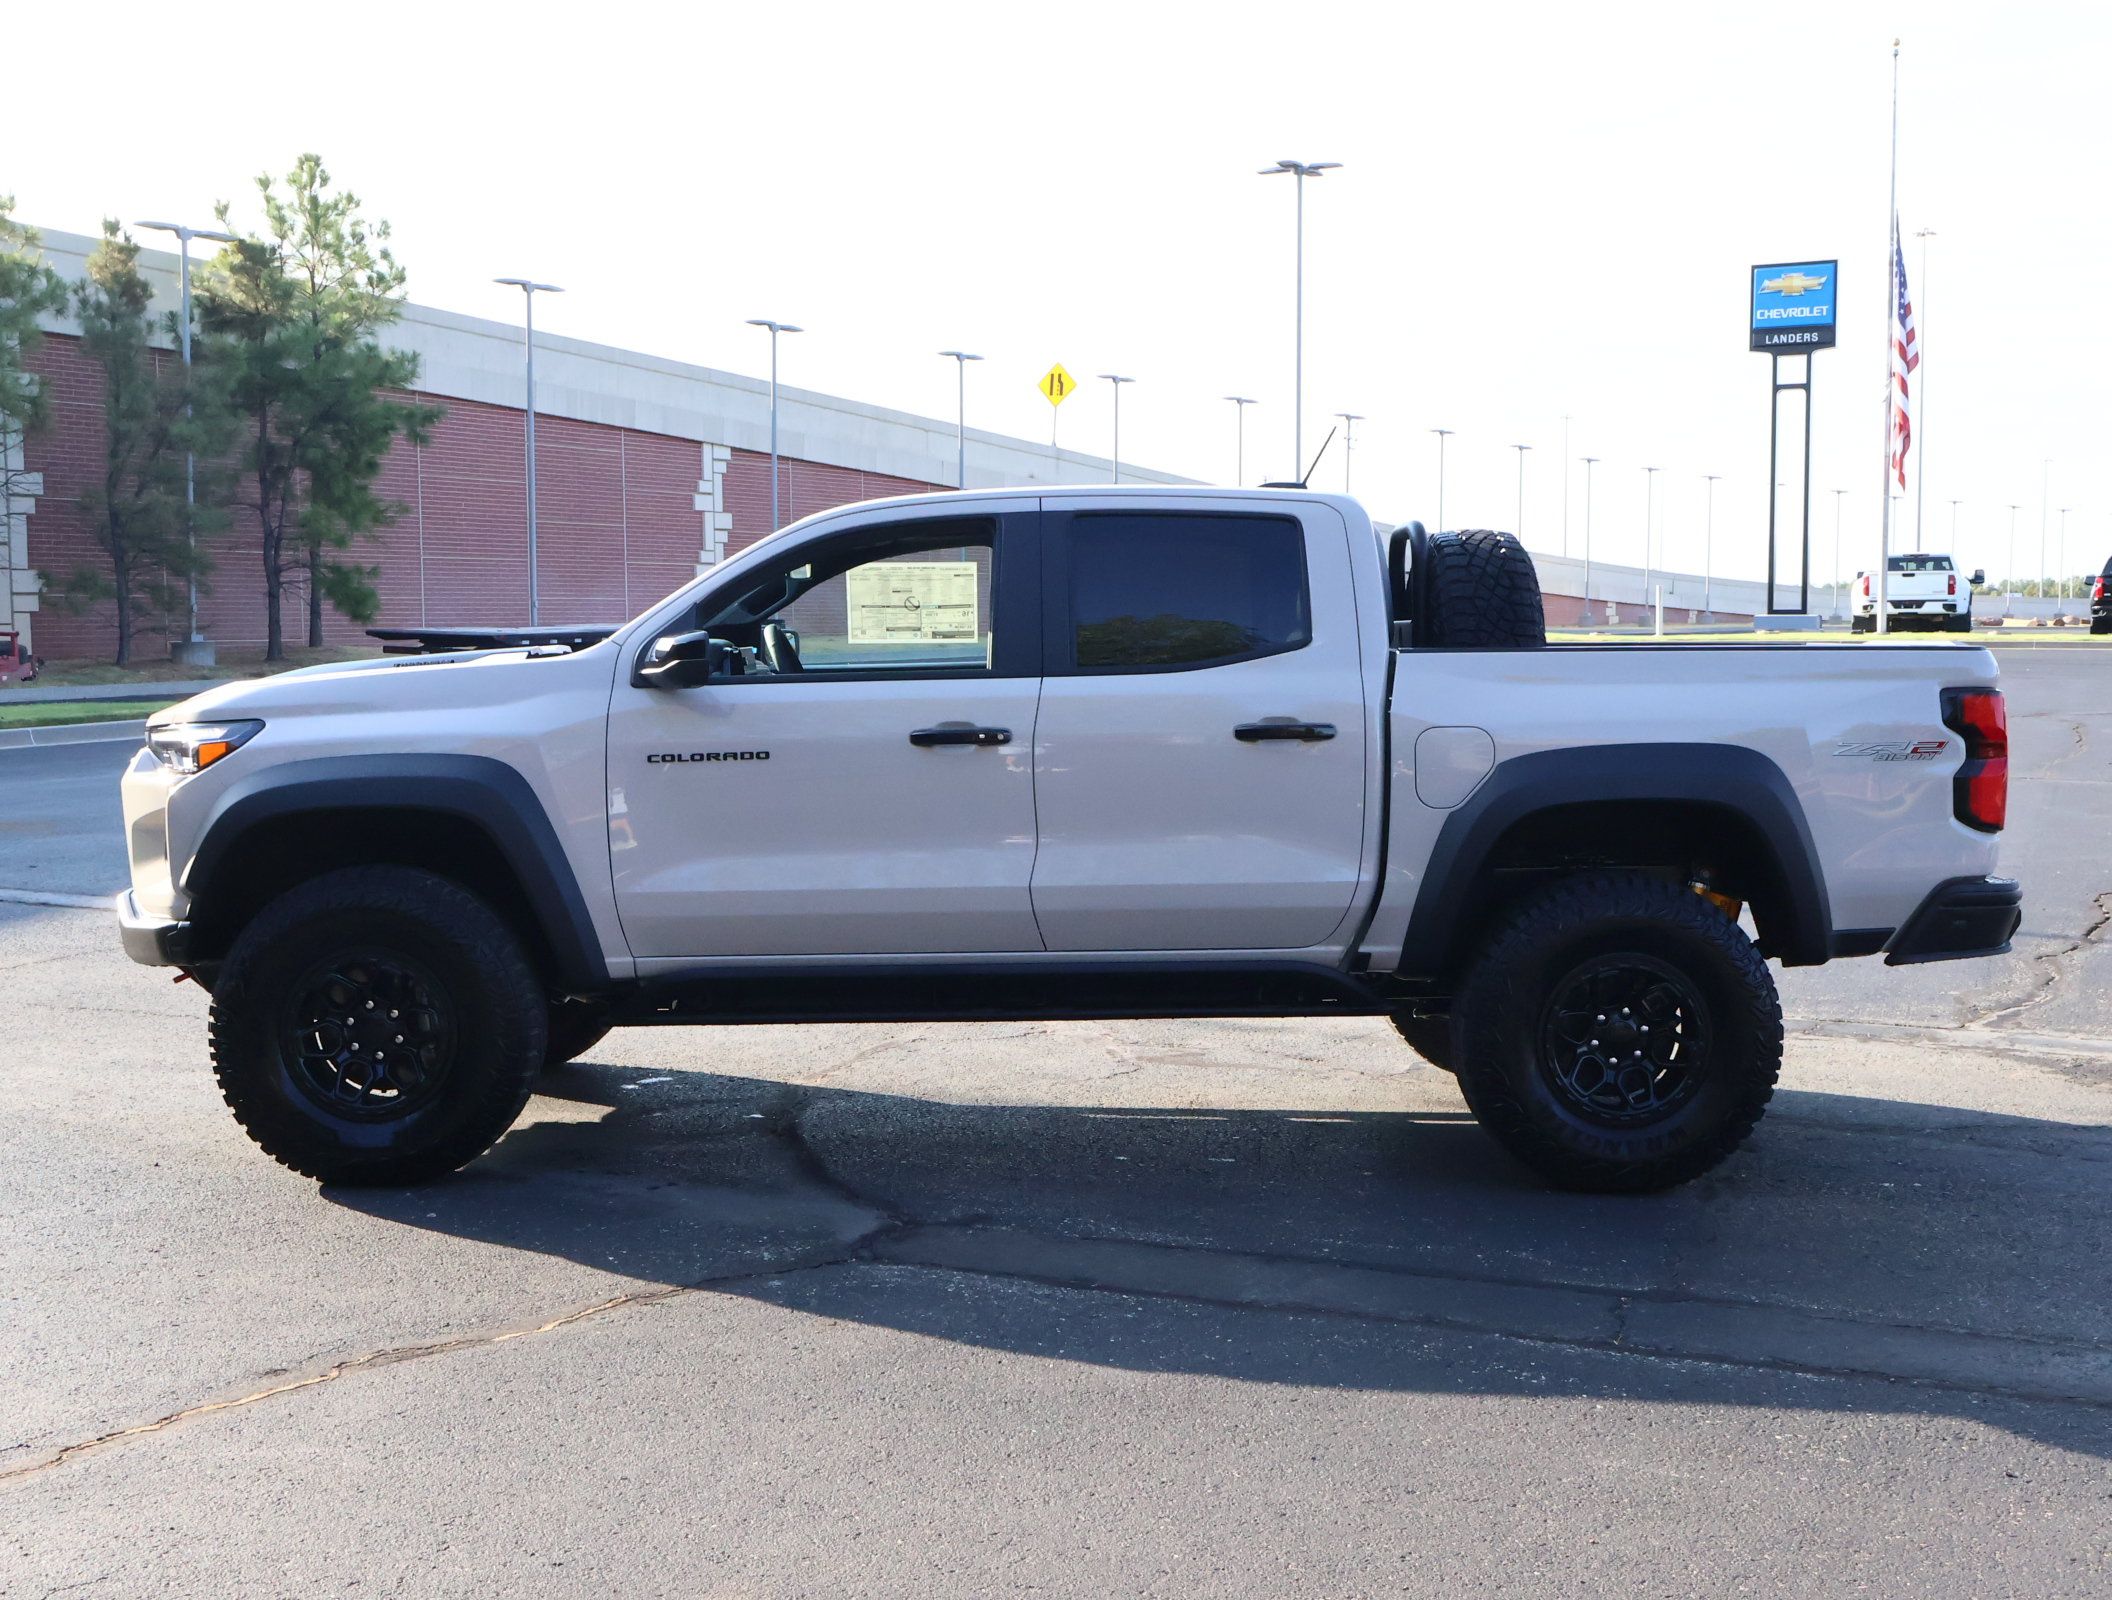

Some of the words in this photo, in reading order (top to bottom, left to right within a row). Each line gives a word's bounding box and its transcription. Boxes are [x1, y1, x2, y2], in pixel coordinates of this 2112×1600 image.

[1757, 305, 1829, 320] CHEVROLET
[1765, 333, 1819, 345] LANDERS
[647, 751, 770, 763] COLORADO
[1873, 752, 1938, 762] BISON
